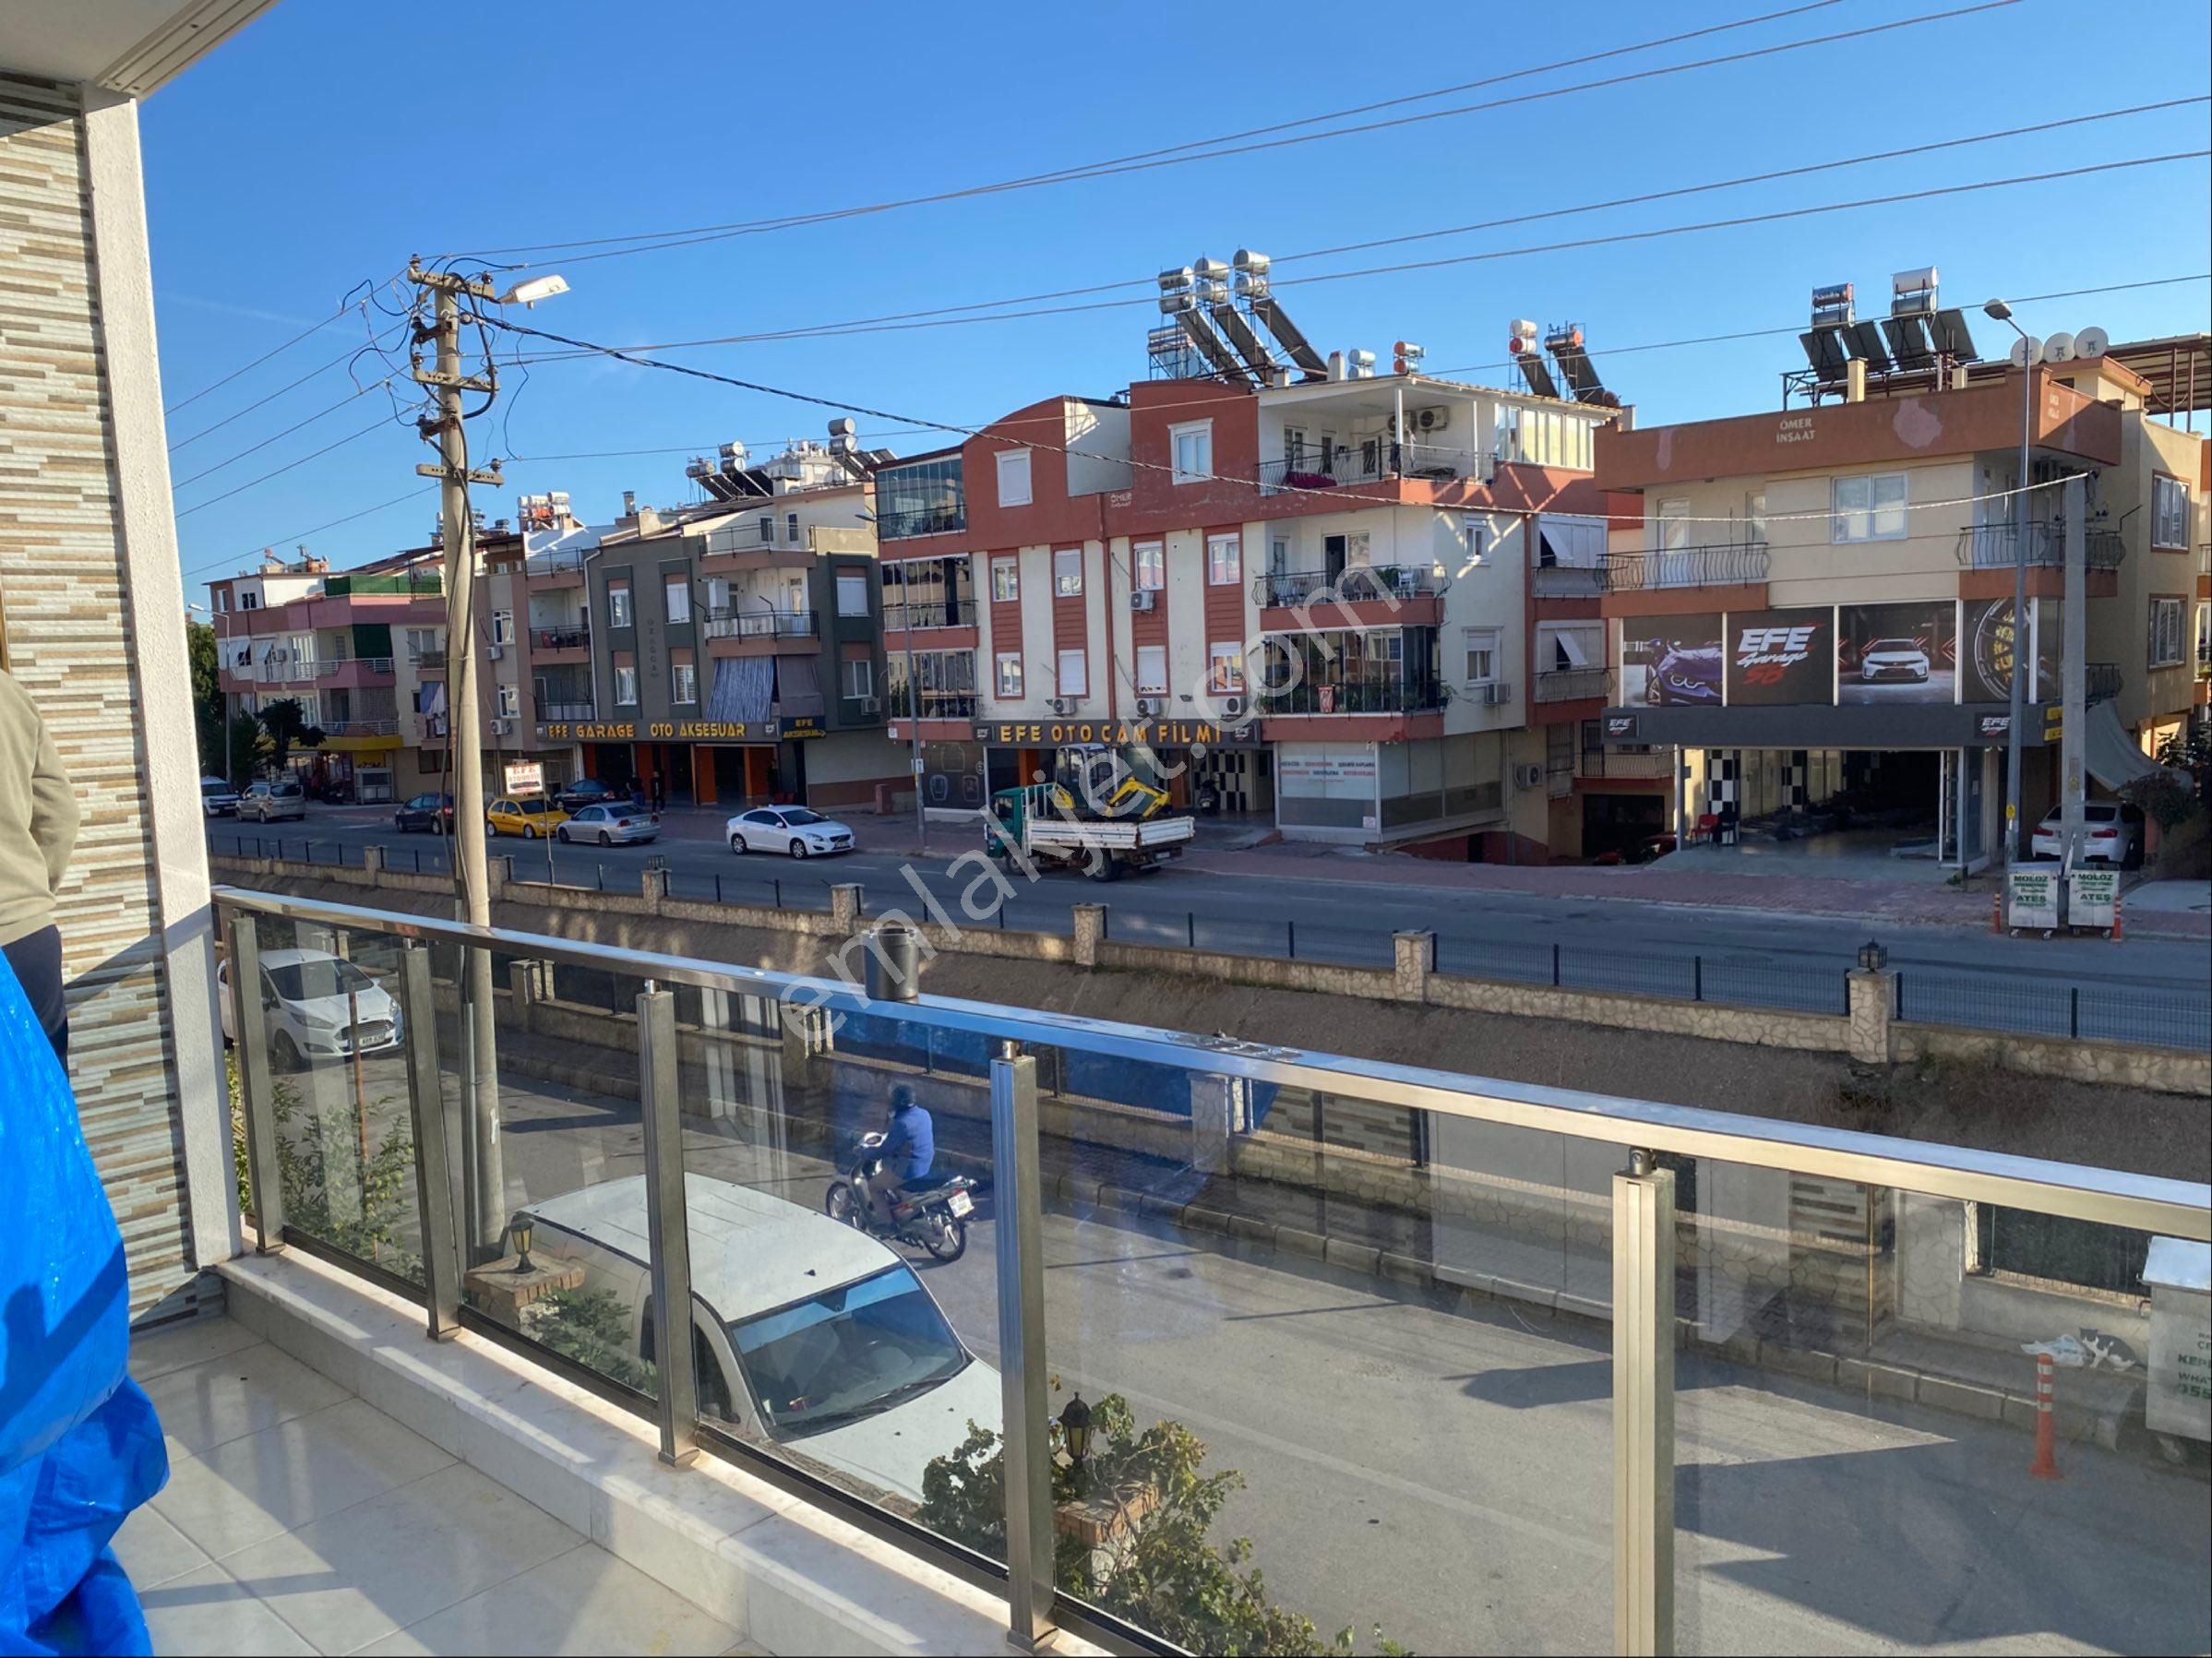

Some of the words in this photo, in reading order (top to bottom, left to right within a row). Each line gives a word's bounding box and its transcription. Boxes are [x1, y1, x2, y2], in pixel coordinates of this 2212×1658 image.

[1738, 626, 1816, 652] EFE
[548, 724, 568, 738] EFE
[576, 723, 635, 738] GARAGE
[650, 722, 673, 737] OTO
[679, 722, 746, 737] AKSESUAR
[1981, 716, 2012, 726] EFE
[999, 725, 1042, 743] EFE
[1051, 724, 1093, 743] OTO
[1101, 724, 1148, 743] CAM
[1158, 722, 1221, 743] FİLMİ
